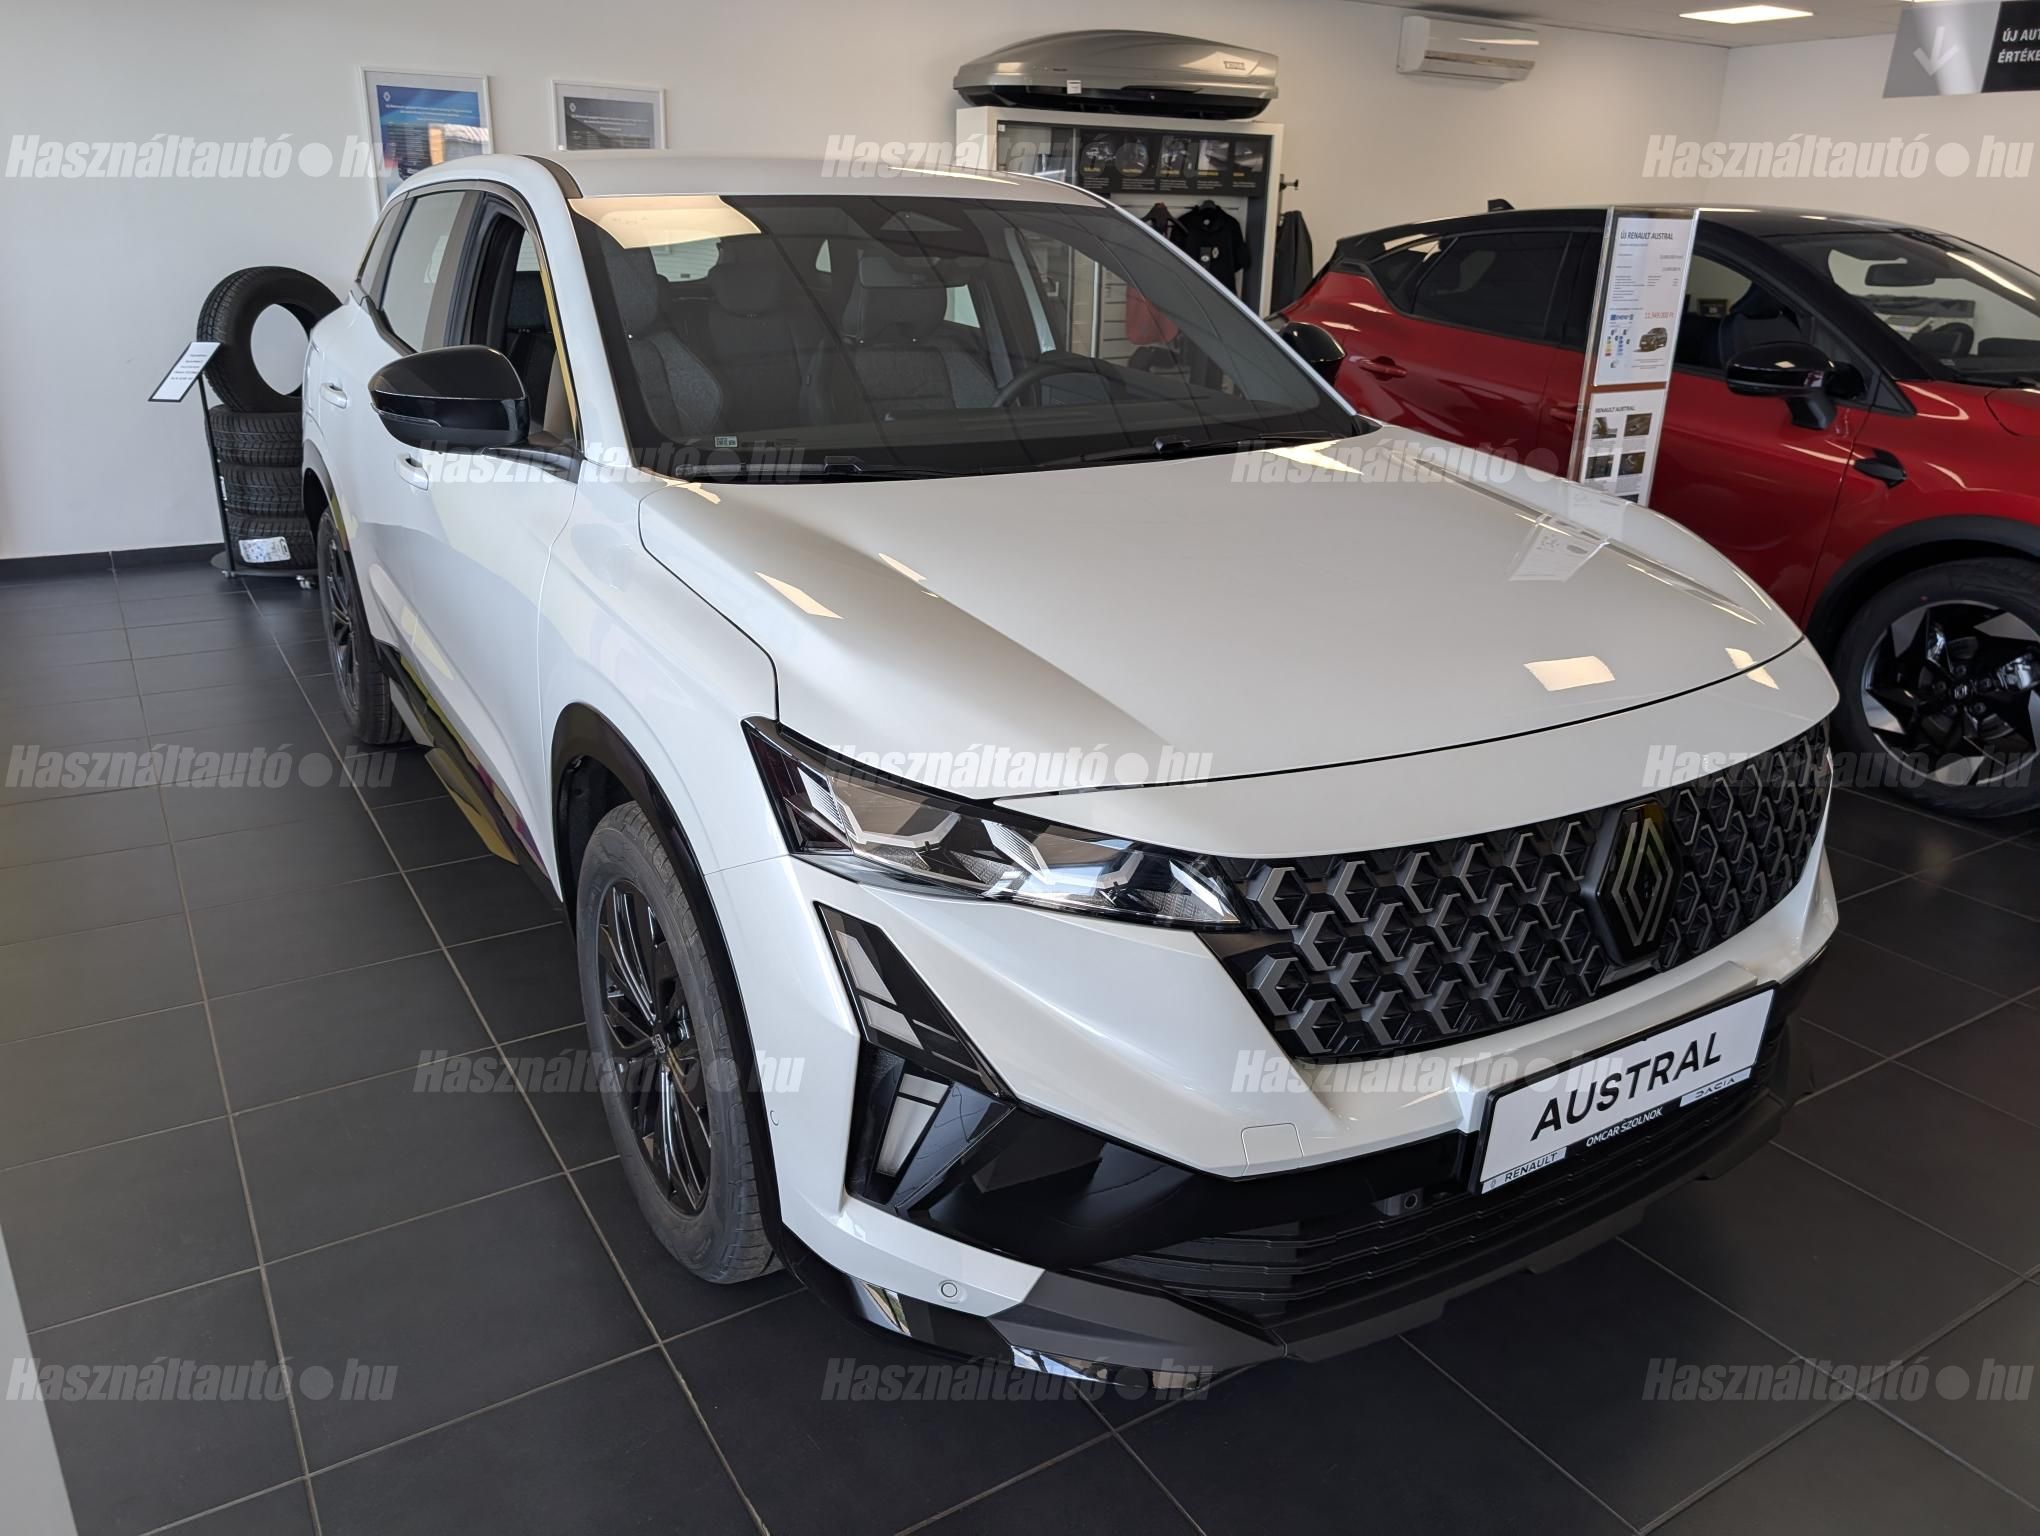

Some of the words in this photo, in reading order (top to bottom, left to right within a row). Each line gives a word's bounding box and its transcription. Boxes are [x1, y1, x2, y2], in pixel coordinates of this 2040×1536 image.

[2002, 28, 2018, 42] ÚJ
[1628, 231, 1650, 240] RENAULT
[1651, 232, 1673, 240] AUSTRAL
[1530, 1031, 1721, 1141] AUSTRAL
[1695, 1077, 1736, 1098] DACIA
[1586, 1125, 1620, 1147] OMCAR
[1620, 1106, 1664, 1133] SZOLNOK
[1504, 1152, 1558, 1182] RENAULT
